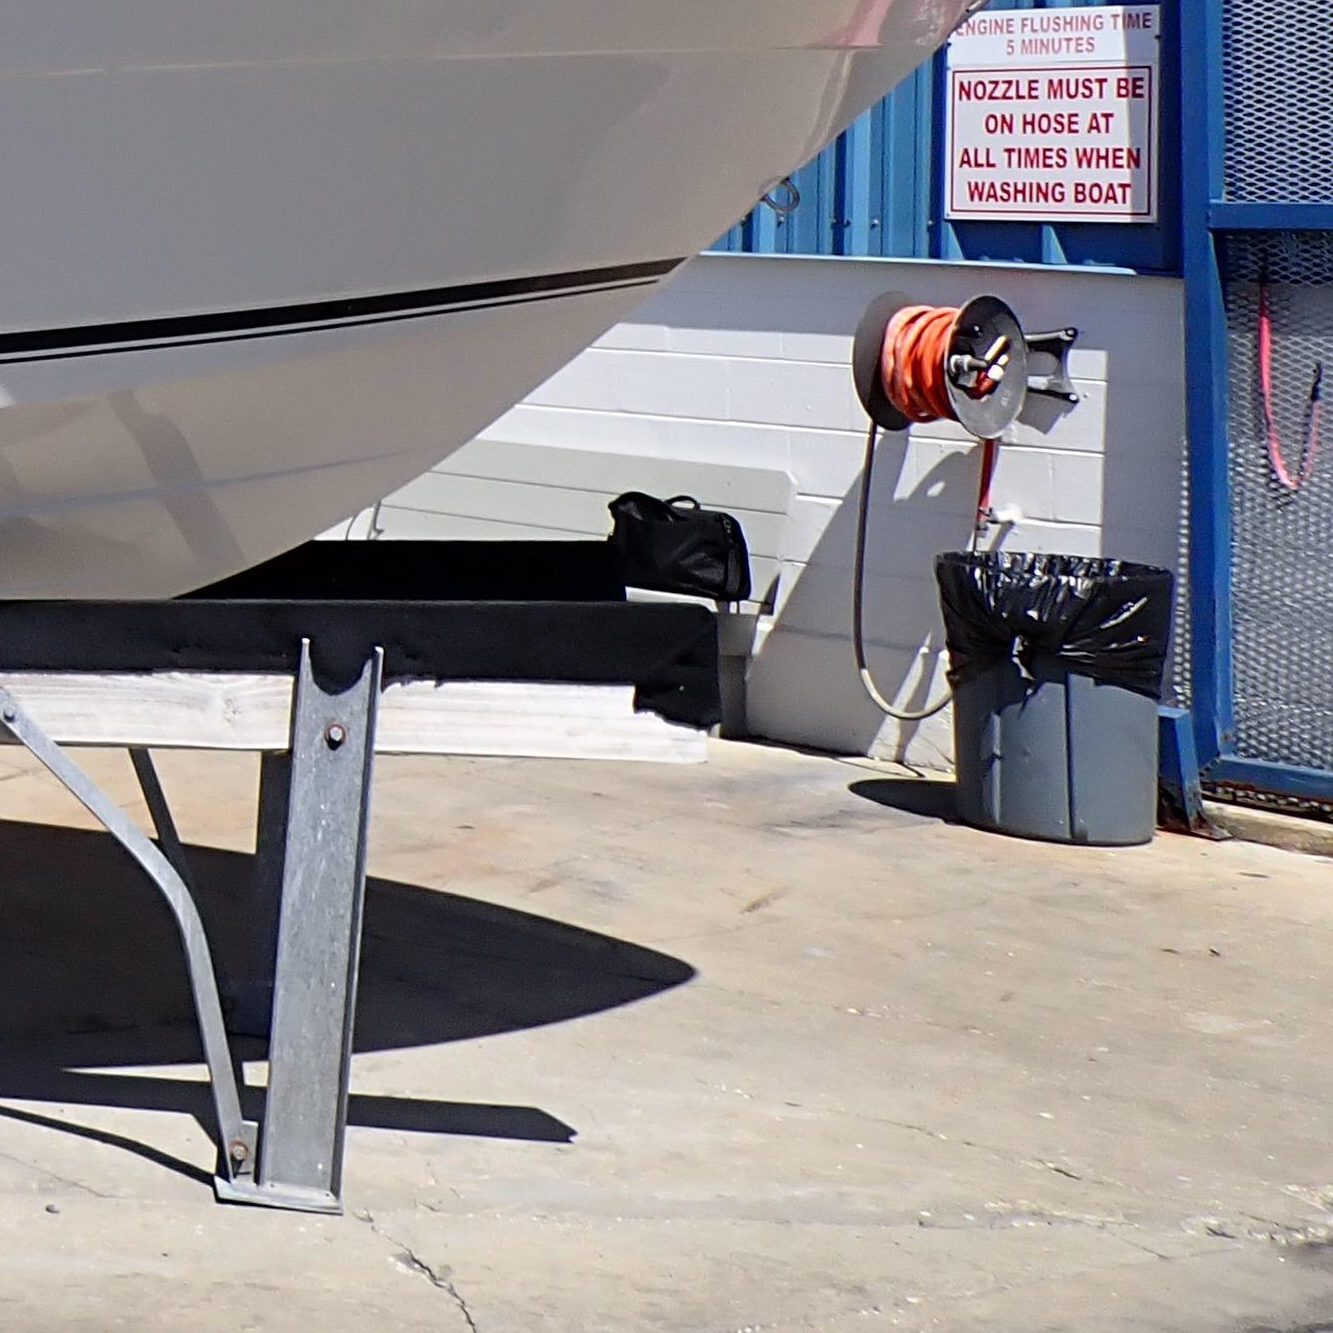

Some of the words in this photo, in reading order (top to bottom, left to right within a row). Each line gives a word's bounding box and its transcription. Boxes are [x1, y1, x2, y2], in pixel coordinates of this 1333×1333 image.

[1021, 15, 1104, 35] FLUSHING
[1111, 12, 1152, 30] TIME
[1006, 40, 1014, 56] 5
[1021, 37, 1095, 55] MINUTES
[959, 80, 1039, 100] NOZZLE
[1047, 78, 1108, 99] MUST
[1116, 77, 1145, 99] BE
[985, 114, 1013, 134] ON
[1022, 113, 1079, 134] HOSE
[1087, 113, 1114, 134] AT
[959, 148, 996, 168] ALL
[1003, 148, 1068, 169] TIMES
[1075, 148, 1141, 169] WHEN
[967, 181, 1065, 203] WASHING
[1074, 183, 1132, 204] BOAT
